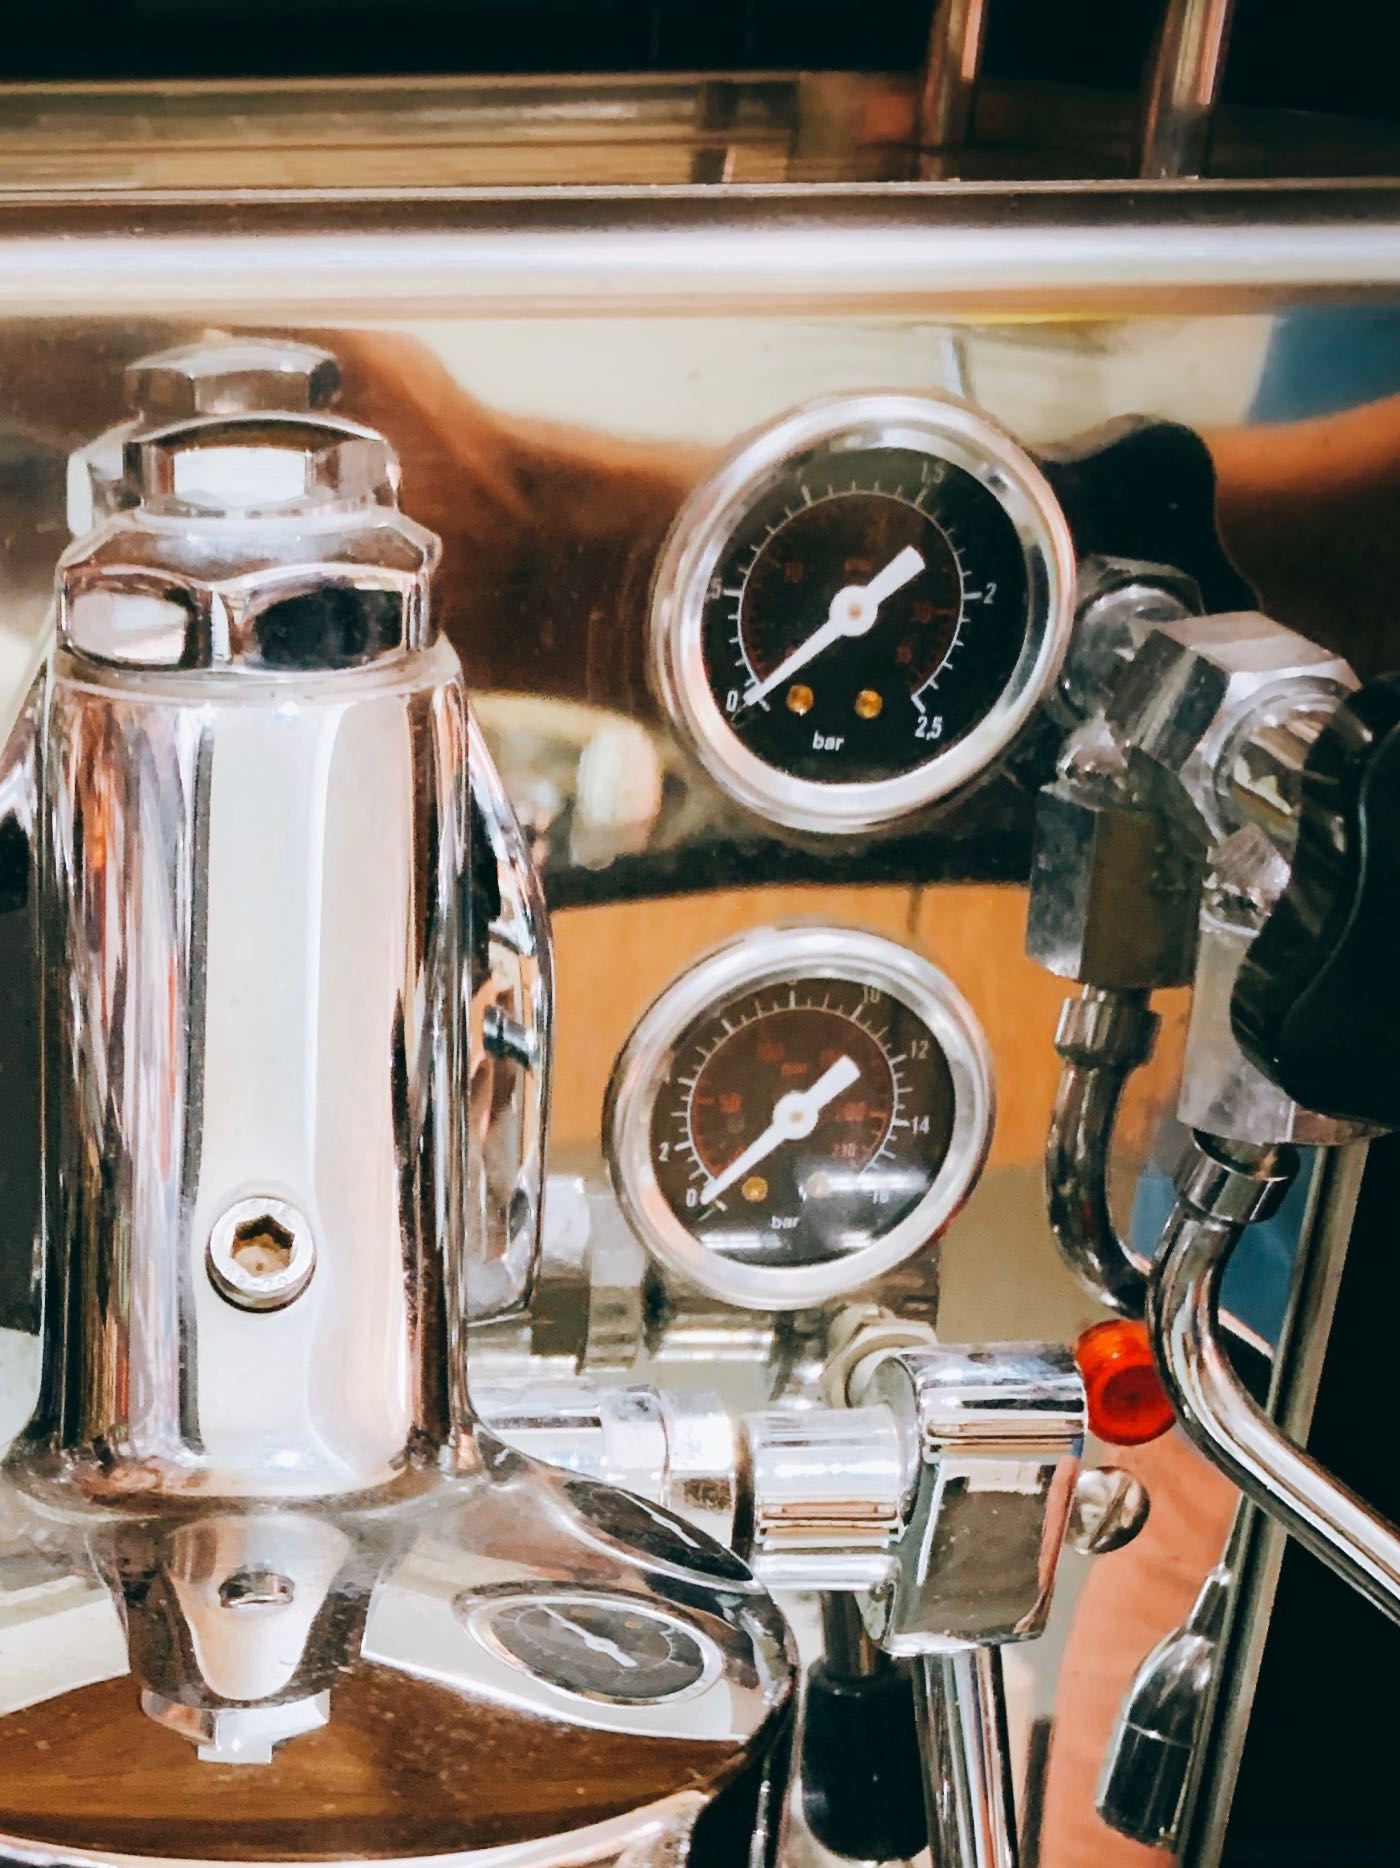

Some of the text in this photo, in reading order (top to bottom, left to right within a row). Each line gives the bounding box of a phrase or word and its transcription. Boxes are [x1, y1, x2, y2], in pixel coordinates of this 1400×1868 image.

[983, 582, 997, 604] 2
[914, 715, 944, 741] 2,5
[812, 730, 845, 751] bar
[911, 1040, 930, 1059] 12
[912, 1115, 930, 1135] 14
[659, 1141, 670, 1162] 2
[770, 1214, 800, 1230] bar
